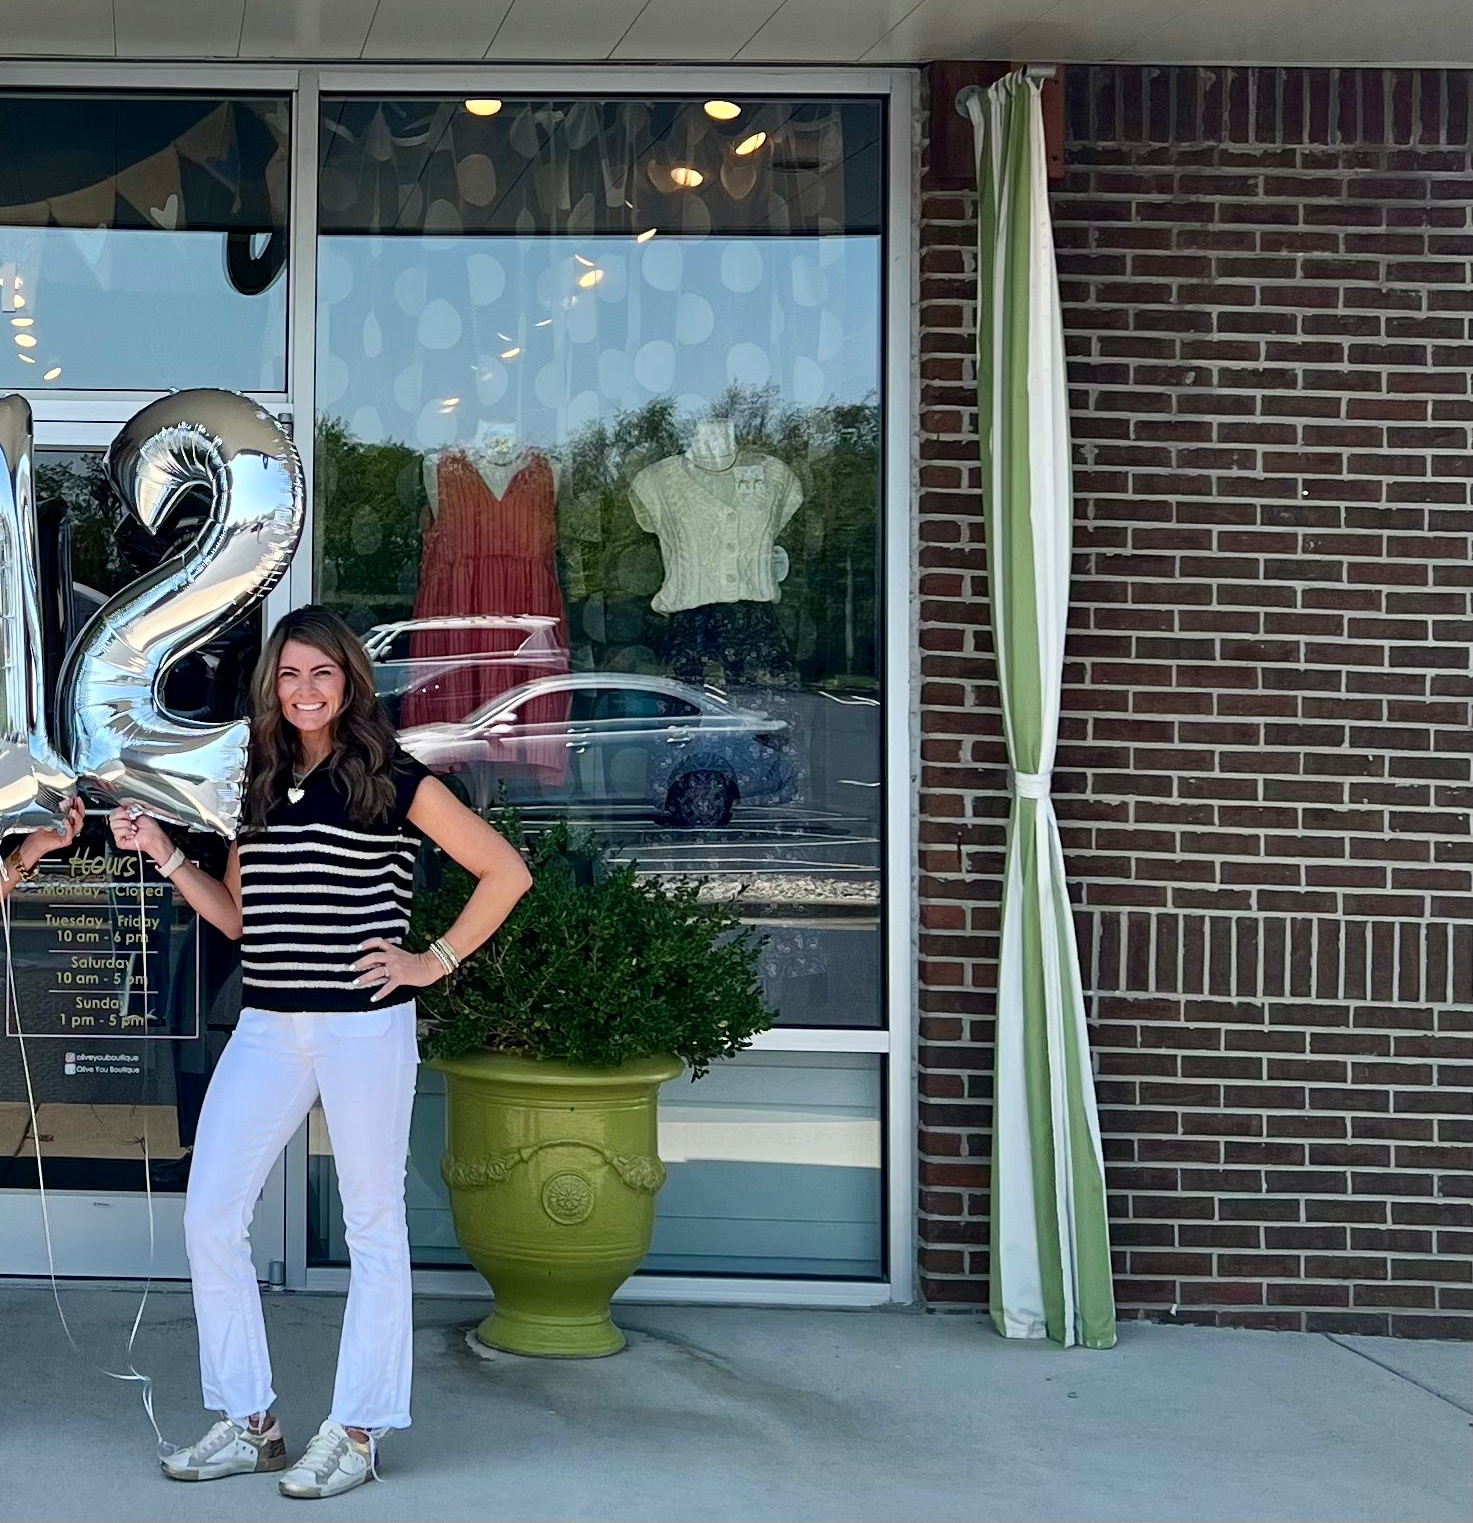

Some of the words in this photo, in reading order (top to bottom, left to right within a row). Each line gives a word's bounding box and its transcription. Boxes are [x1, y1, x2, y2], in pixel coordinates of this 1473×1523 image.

[68, 845, 138, 877] Hours
[42, 884, 100, 899] Monday
[44, 914, 104, 929] Tuesday
[117, 914, 160, 930] Friday
[57, 930, 73, 942] 10
[76, 932, 99, 942] am
[113, 930, 122, 942] 6
[125, 932, 149, 945] pm
[56, 971, 72, 984] 10
[76, 974, 99, 984] am
[113, 972, 121, 984] 5
[76, 996, 121, 1009] Sunda
[60, 1013, 66, 1025] 1
[71, 1016, 95, 1029] pm
[108, 1014, 117, 1026] 5
[121, 1016, 145, 1029] pm
